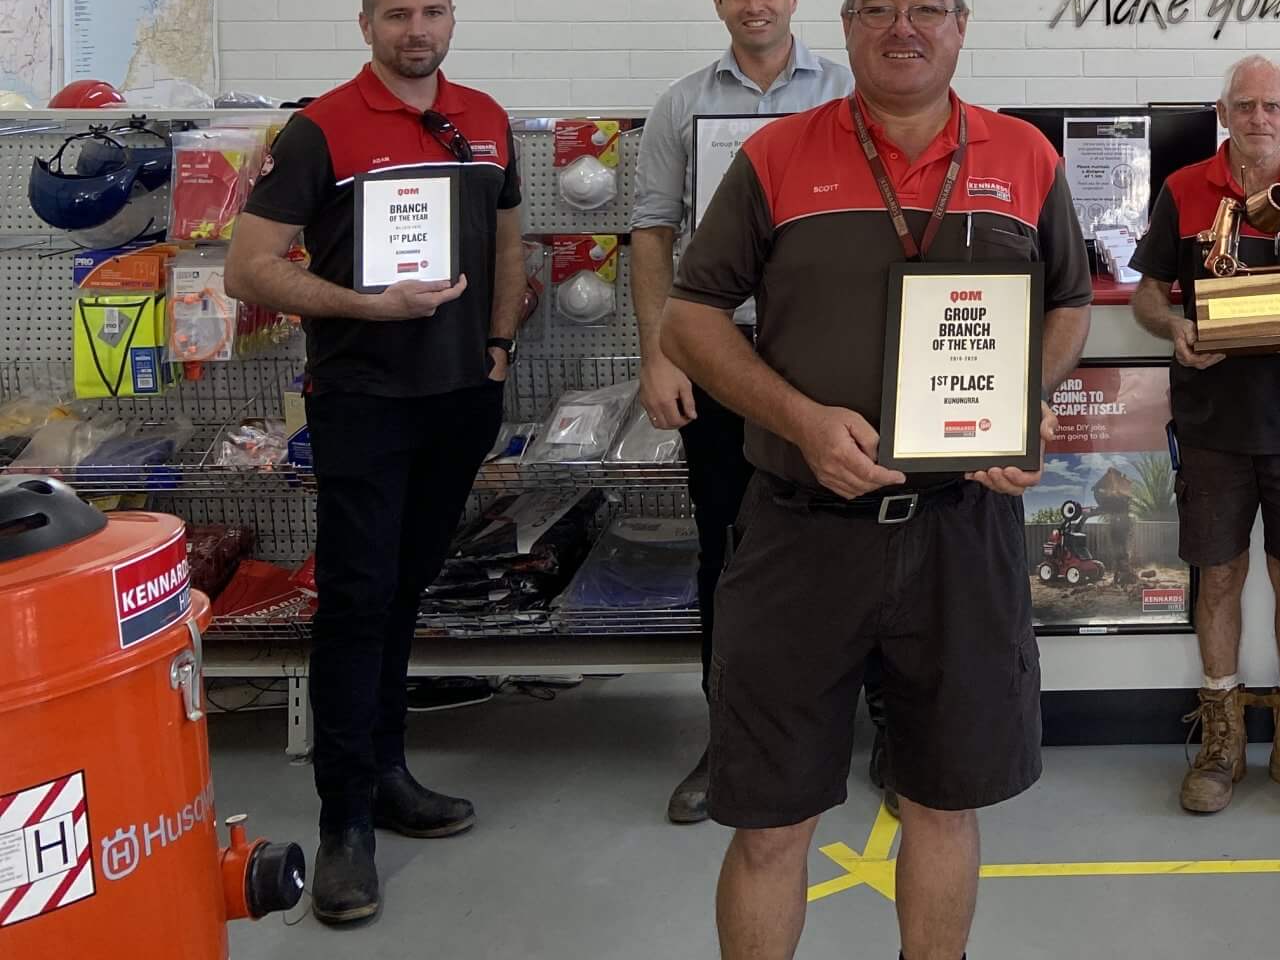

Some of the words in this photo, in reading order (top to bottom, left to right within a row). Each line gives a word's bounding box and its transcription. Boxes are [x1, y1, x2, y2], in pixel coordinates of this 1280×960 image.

[813, 183, 839, 193] SCOTT
[390, 203, 428, 214] BRANCH
[401, 233, 428, 243] PLACE
[75, 258, 94, 266] PRO
[950, 291, 982, 303] QOM
[944, 307, 986, 321] GROUP
[939, 323, 990, 337] BRANCH
[932, 339, 946, 351] OF
[947, 339, 967, 351] THE
[970, 339, 996, 351] YEAR
[930, 376, 948, 392] 1ST
[950, 375, 995, 391] PLACE
[1056, 379, 1082, 391] ARD
[944, 397, 979, 405] KUNUNURRA
[1053, 392, 1087, 403] GOING
[1089, 391, 1103, 402] TO
[1052, 404, 1088, 416] SCAPE
[1089, 403, 1127, 415] ITSELF.
[1068, 433, 1088, 441] going
[34, 820, 69, 874] H
